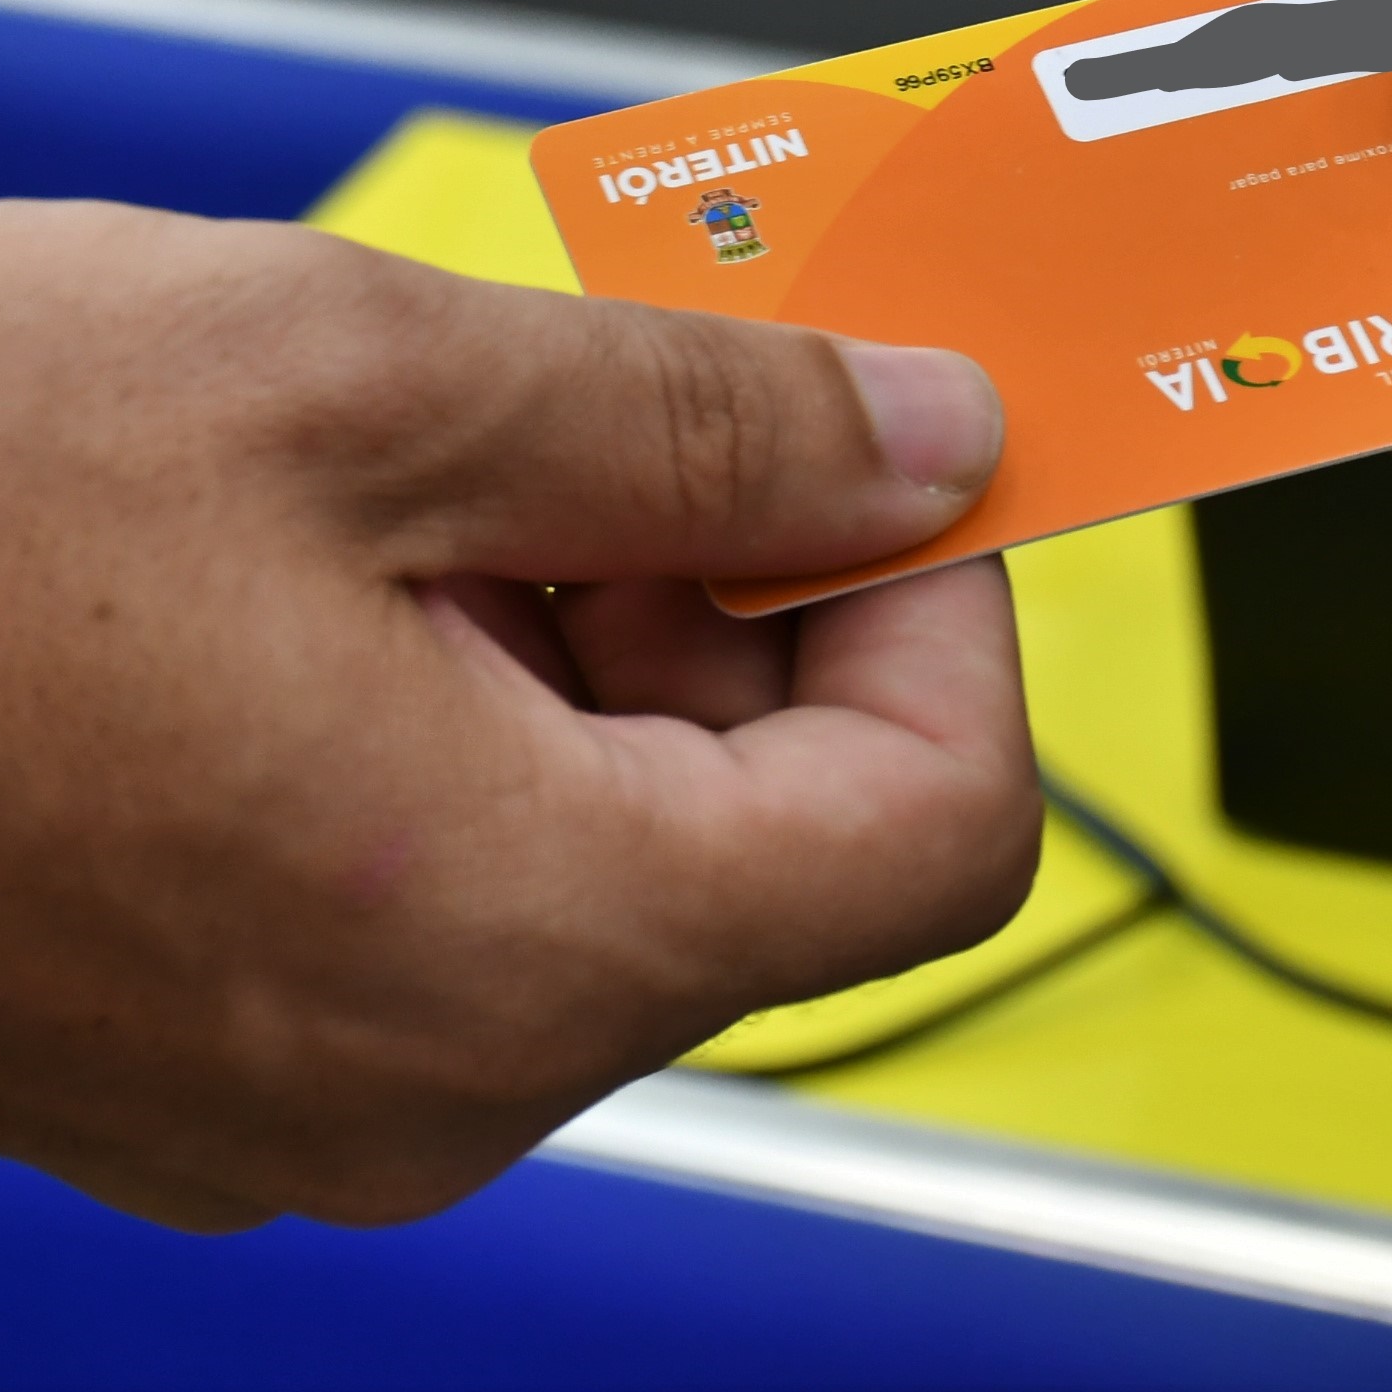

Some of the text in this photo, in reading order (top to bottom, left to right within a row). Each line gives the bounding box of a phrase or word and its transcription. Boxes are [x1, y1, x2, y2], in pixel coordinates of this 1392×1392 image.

[894, 58, 995, 92] BX59P66
[707, 111, 793, 141] SEMPRE
[591, 140, 677, 170] FRENTE
[598, 128, 809, 206] NITERÓI
[1285, 156, 1329, 179] para
[1228, 168, 1282, 192] pagar
